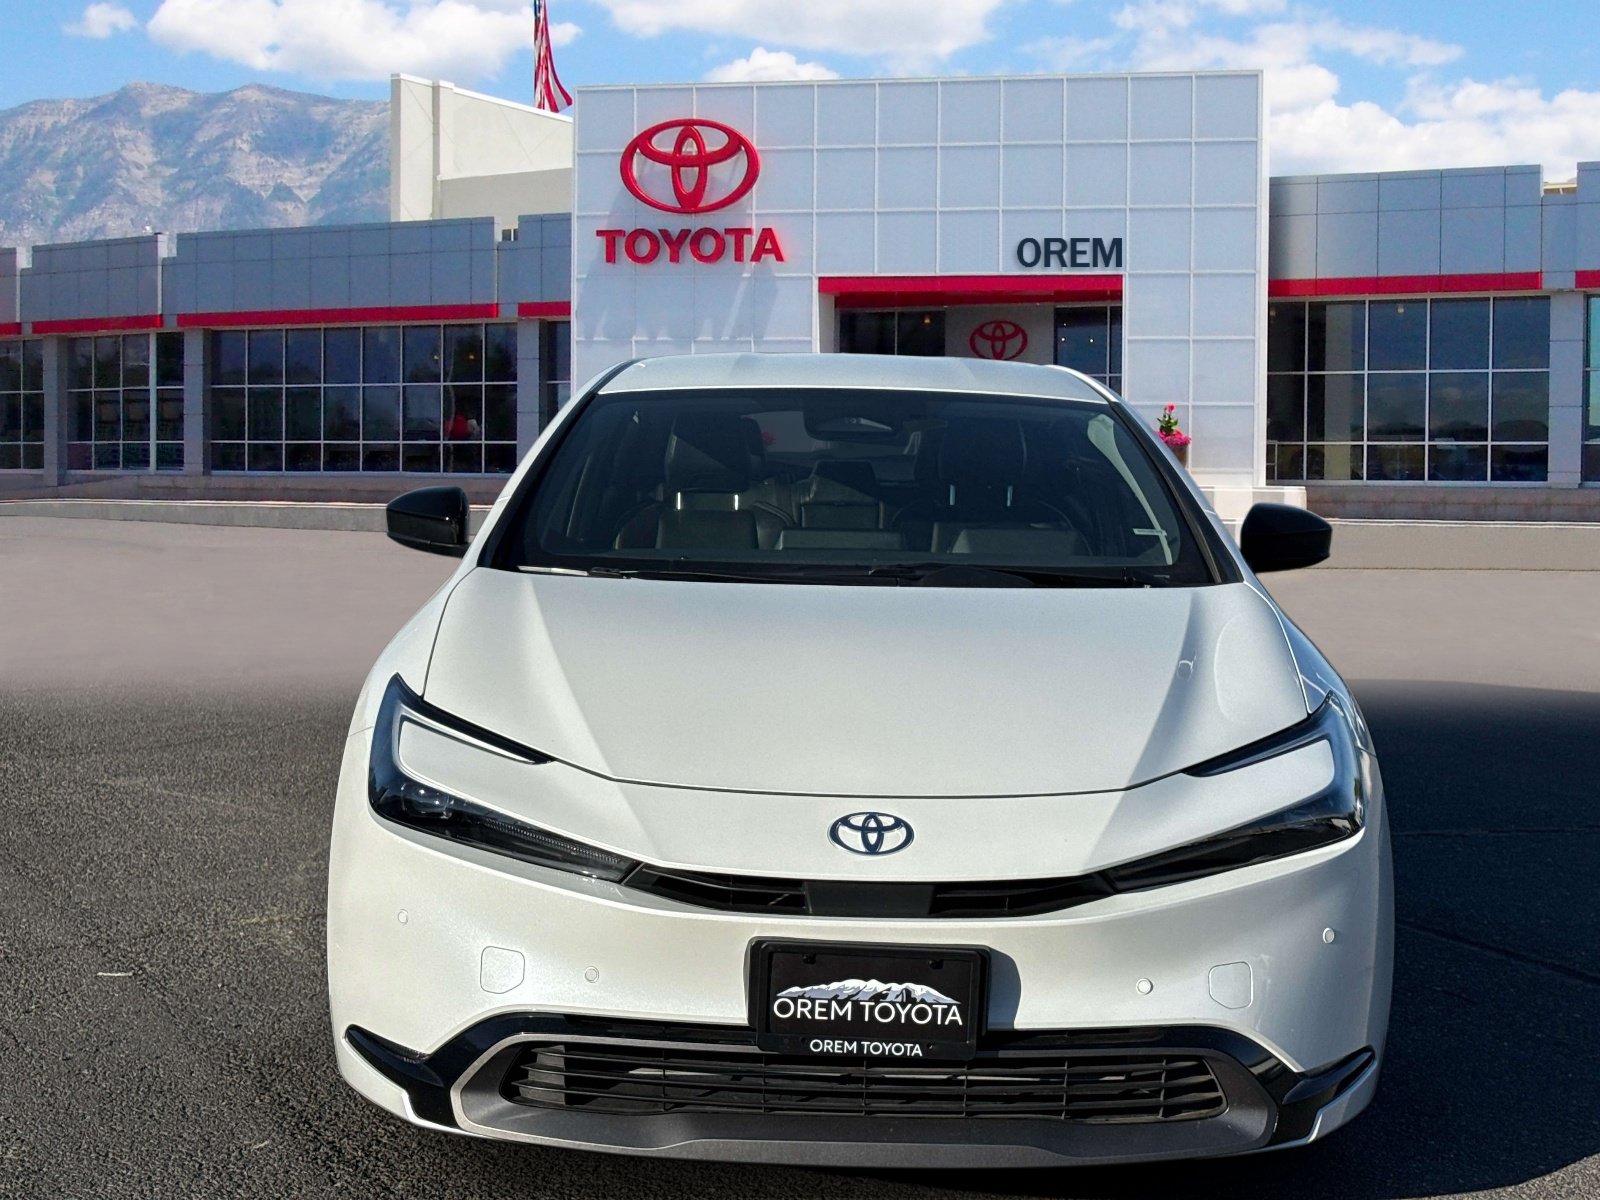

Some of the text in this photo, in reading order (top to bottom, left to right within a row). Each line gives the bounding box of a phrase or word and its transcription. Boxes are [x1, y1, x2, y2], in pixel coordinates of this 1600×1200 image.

[596, 227, 785, 264] TOYOTA
[1017, 238, 1122, 267] OREM
[773, 998, 963, 1026] OREM TOYOTA
[809, 1039, 923, 1057] OREM TOYOTA
